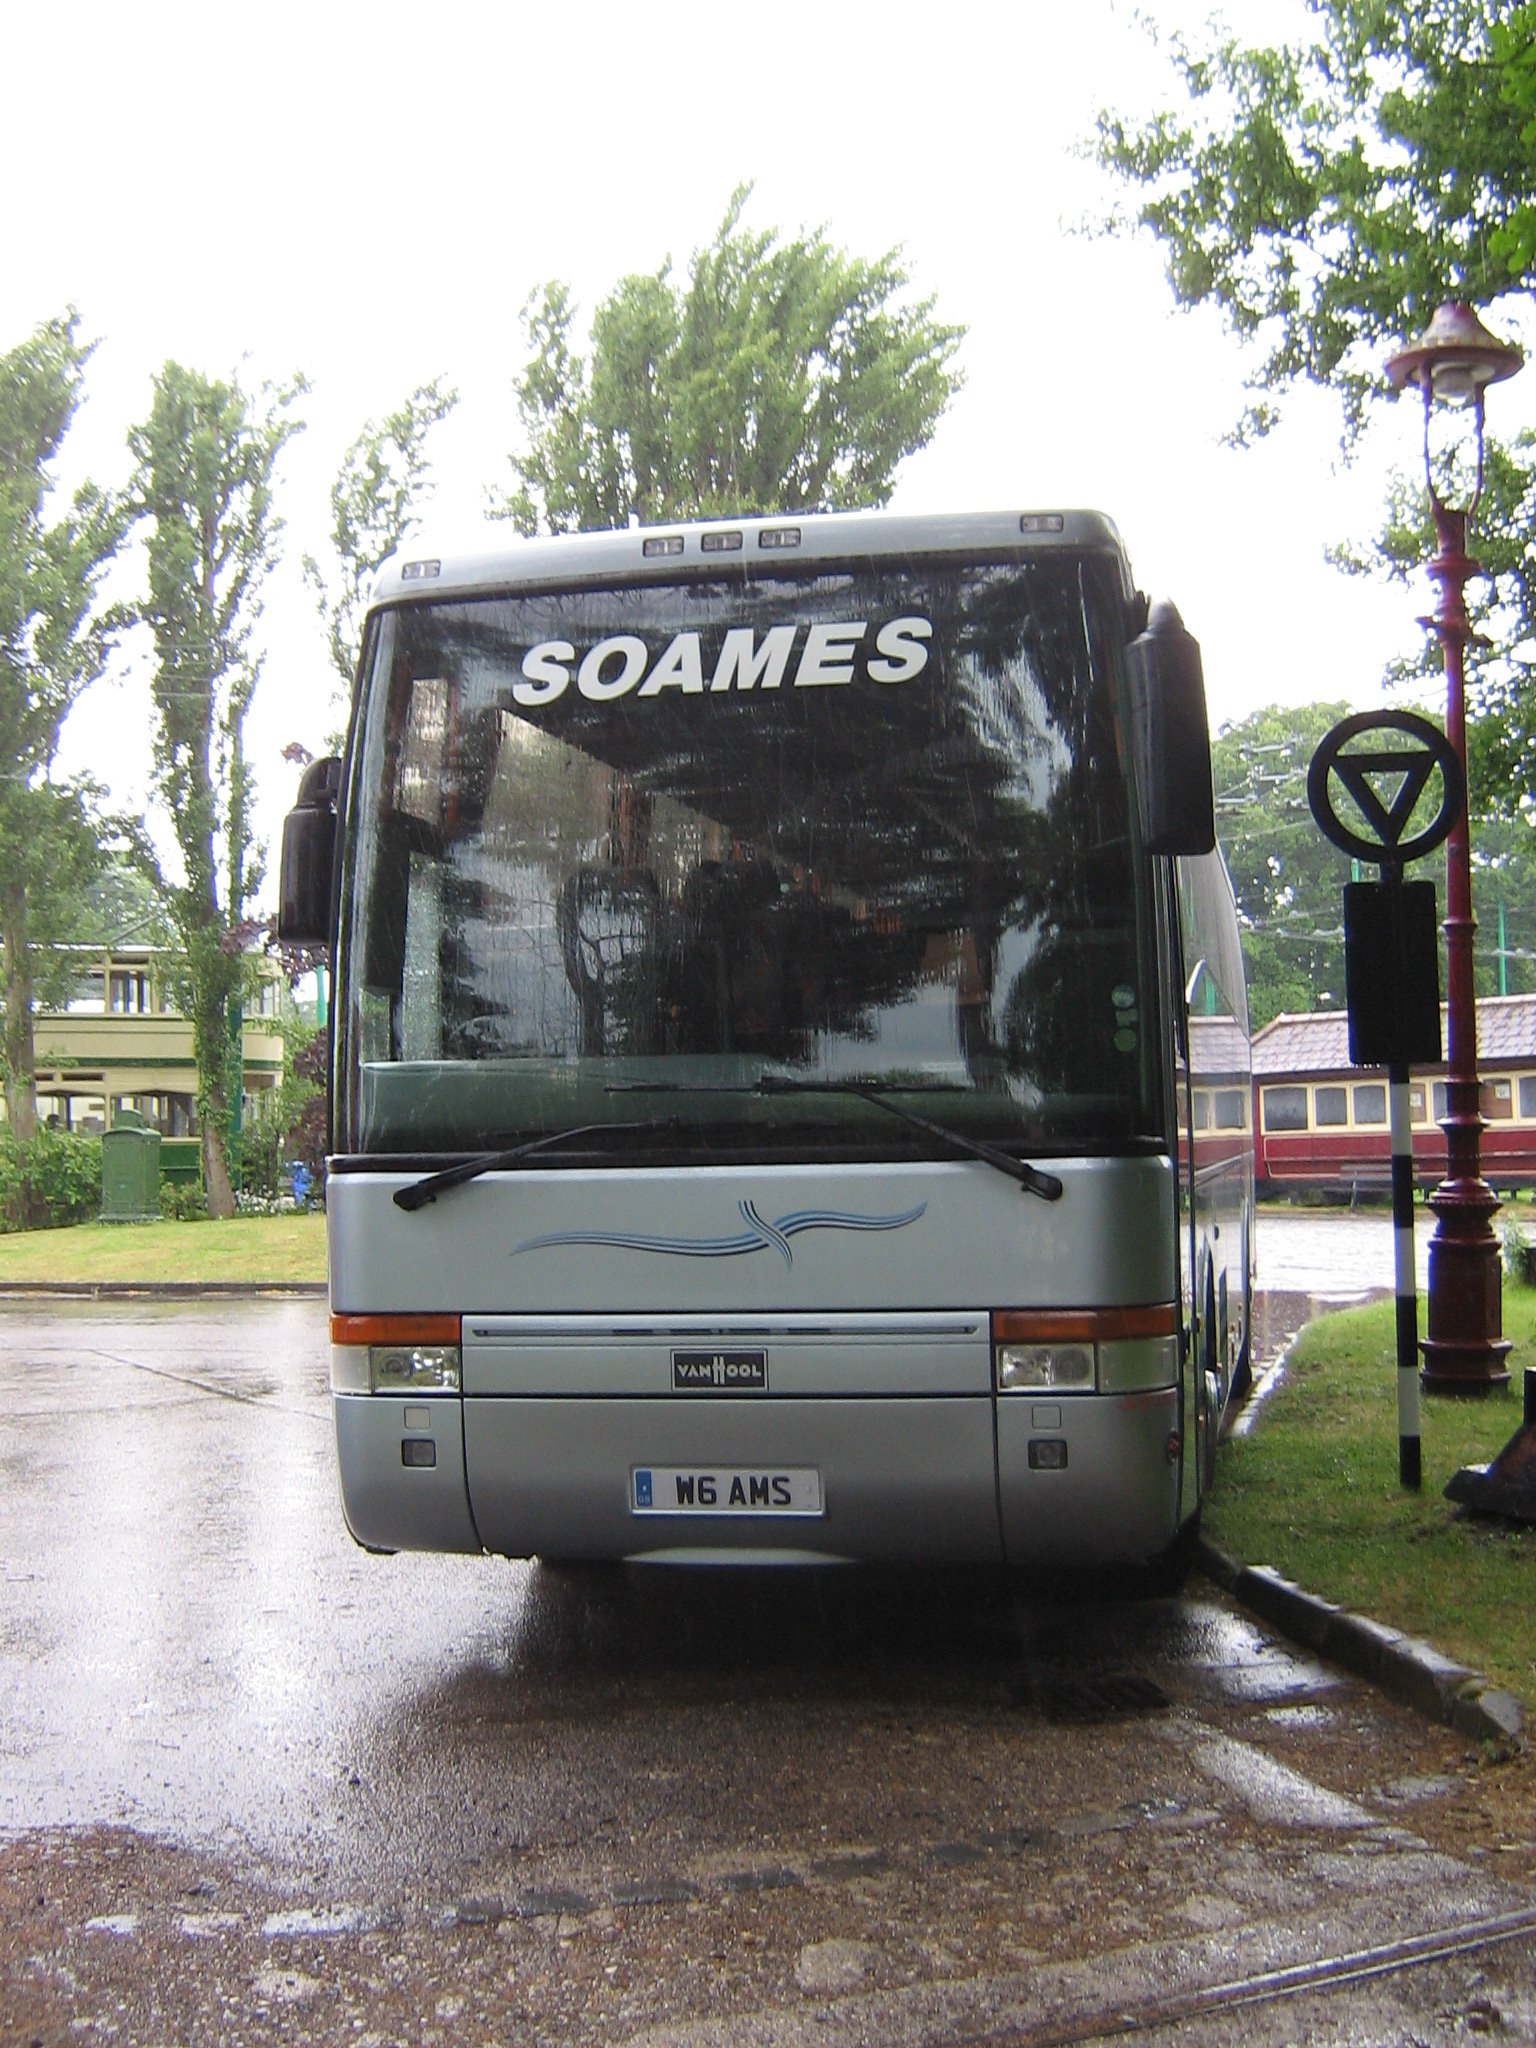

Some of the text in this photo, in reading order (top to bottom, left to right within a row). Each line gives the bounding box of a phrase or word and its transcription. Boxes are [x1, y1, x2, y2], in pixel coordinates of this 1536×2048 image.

[512, 616, 934, 707] SOAMES
[675, 1475, 792, 1506] W6 AMS
